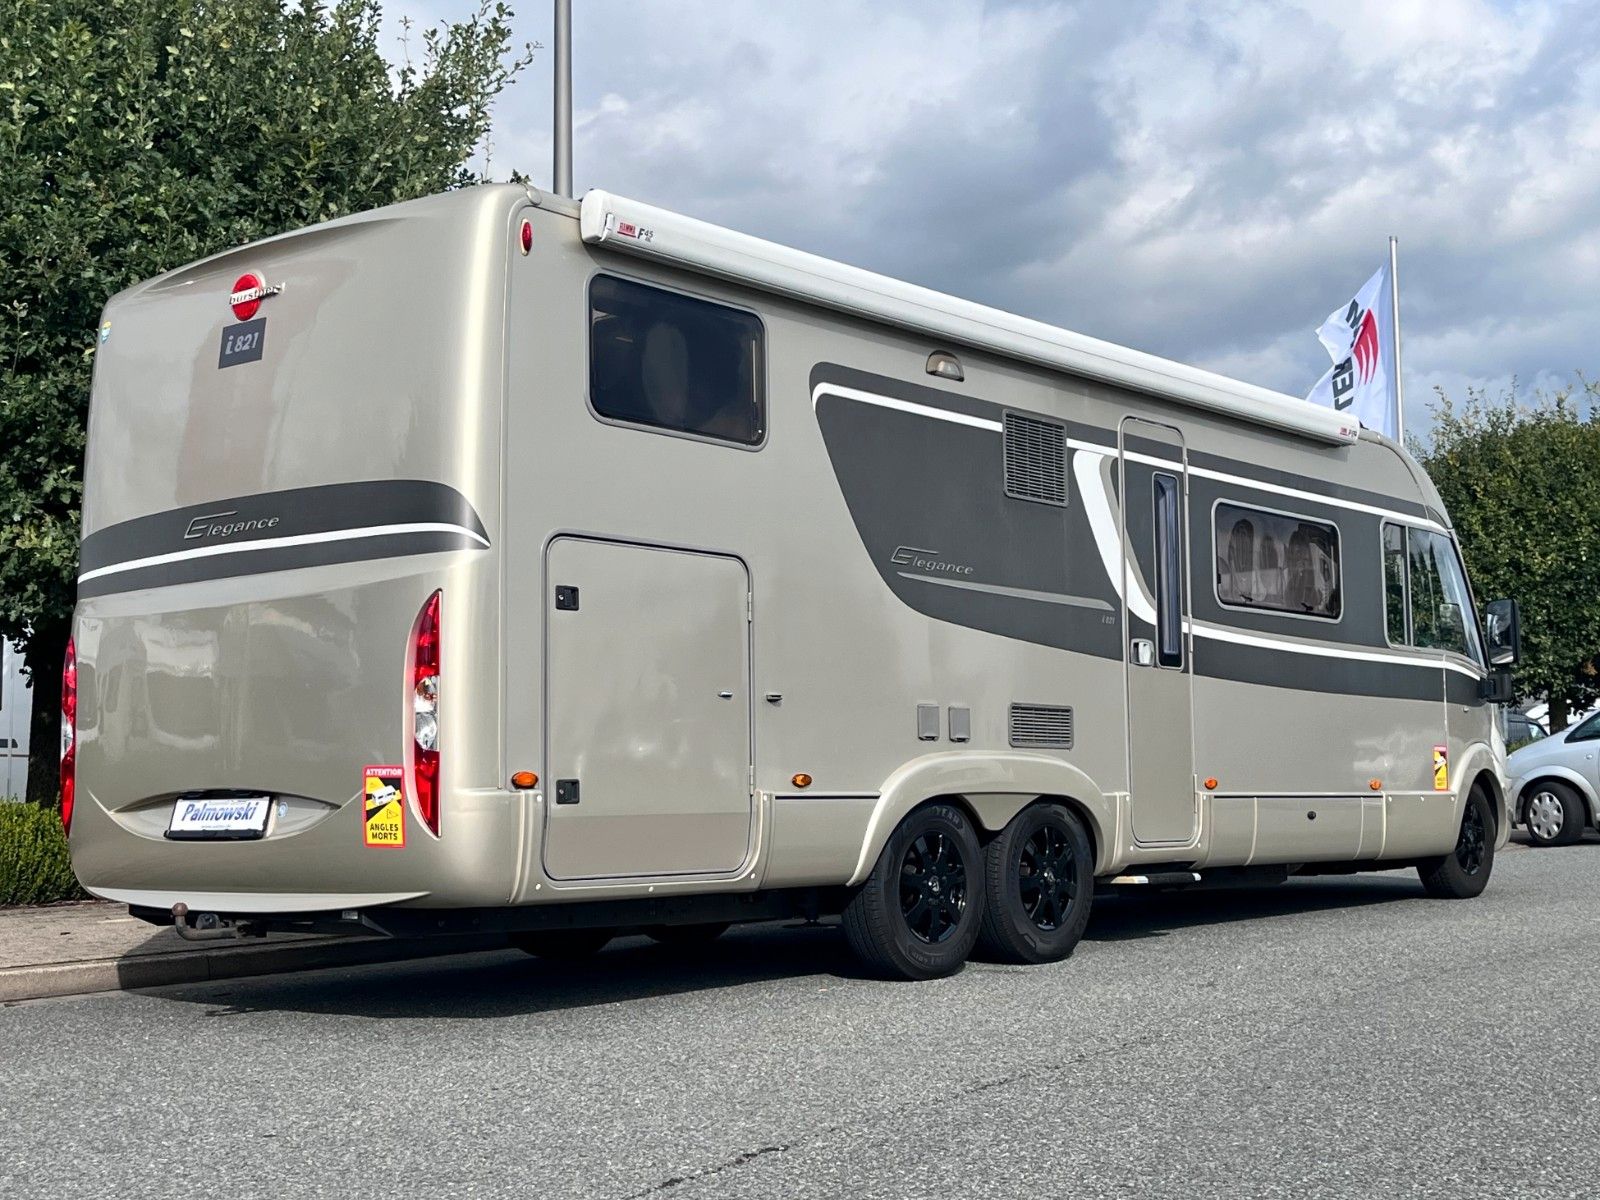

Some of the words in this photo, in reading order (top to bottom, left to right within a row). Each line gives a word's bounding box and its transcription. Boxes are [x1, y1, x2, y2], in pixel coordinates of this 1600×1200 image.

[183, 510, 280, 540] Elegance
[890, 545, 974, 575] Elegance
[365, 768, 403, 776] ATTENTION
[181, 801, 260, 822] Palmowski
[369, 823, 400, 832] ANGLES
[371, 831, 398, 841] MORTS
